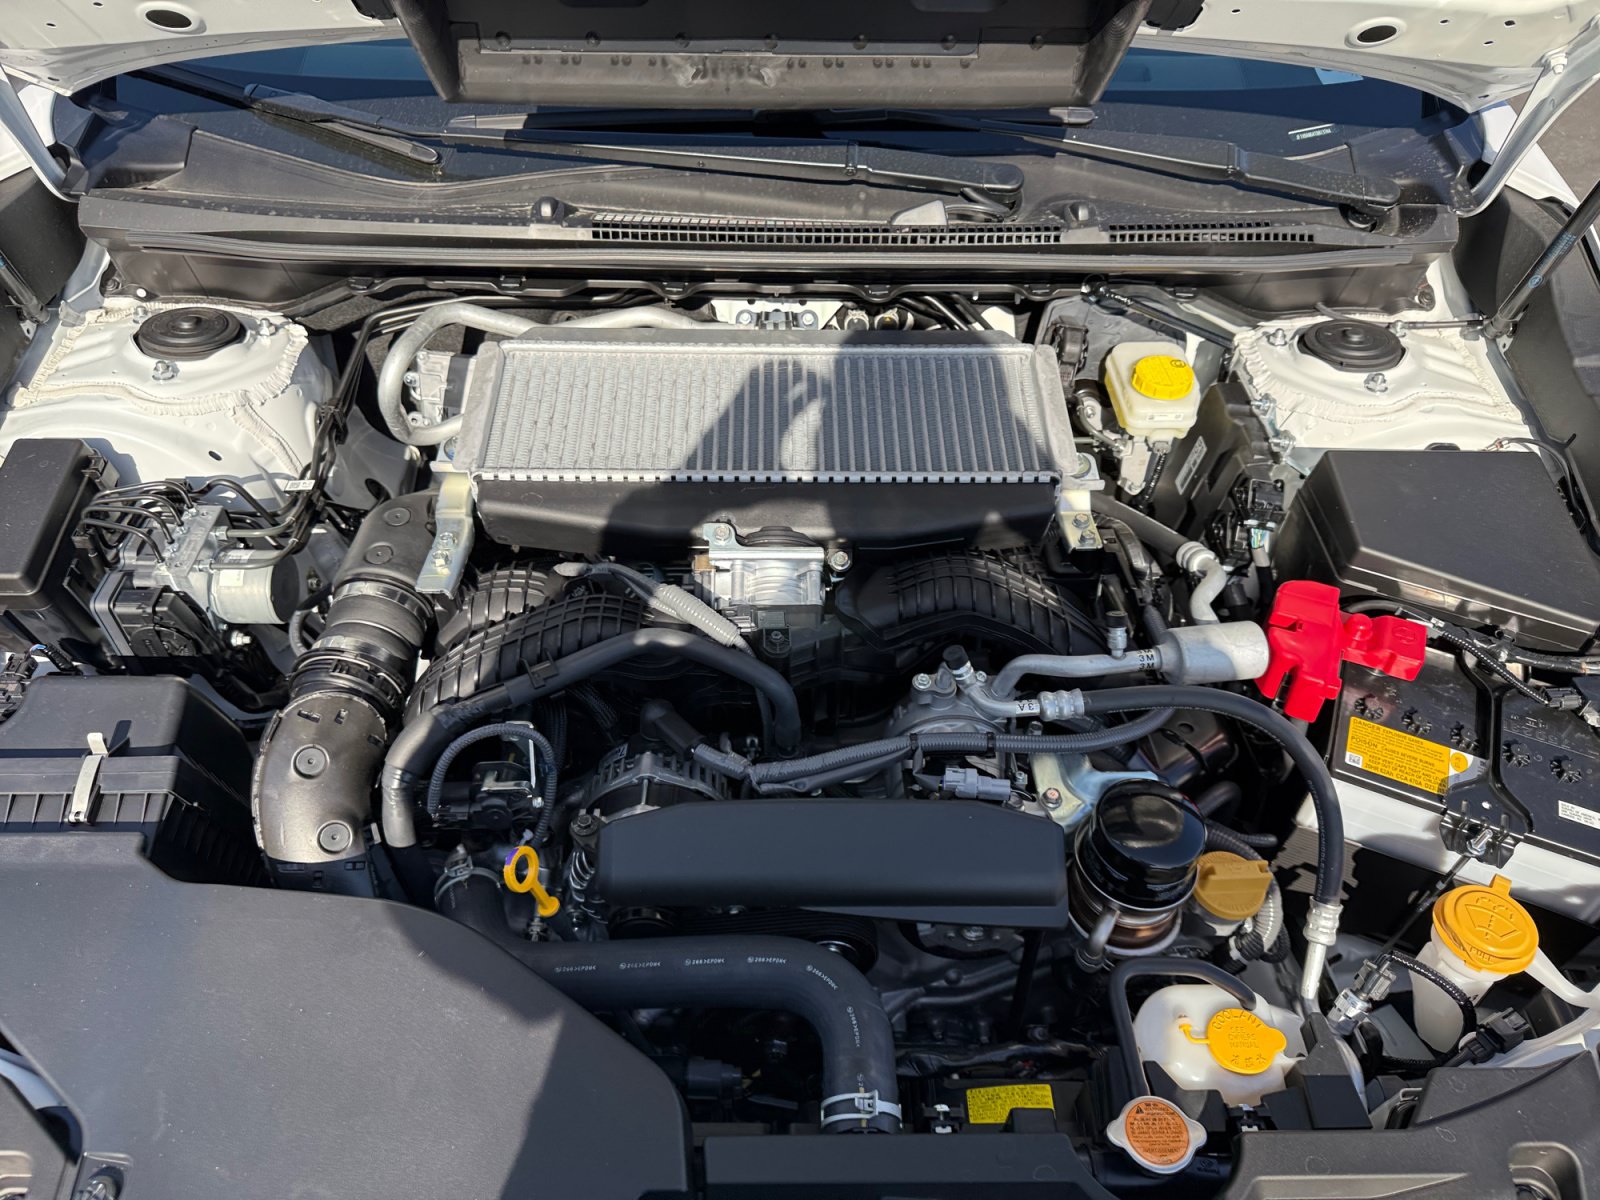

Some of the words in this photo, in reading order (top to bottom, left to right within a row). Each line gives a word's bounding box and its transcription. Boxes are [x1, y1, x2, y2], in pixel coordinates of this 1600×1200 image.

[1353, 719, 1381, 731] DANGER
[1351, 736, 1378, 749] POISON
[1211, 1009, 1264, 1030] COOLANT
